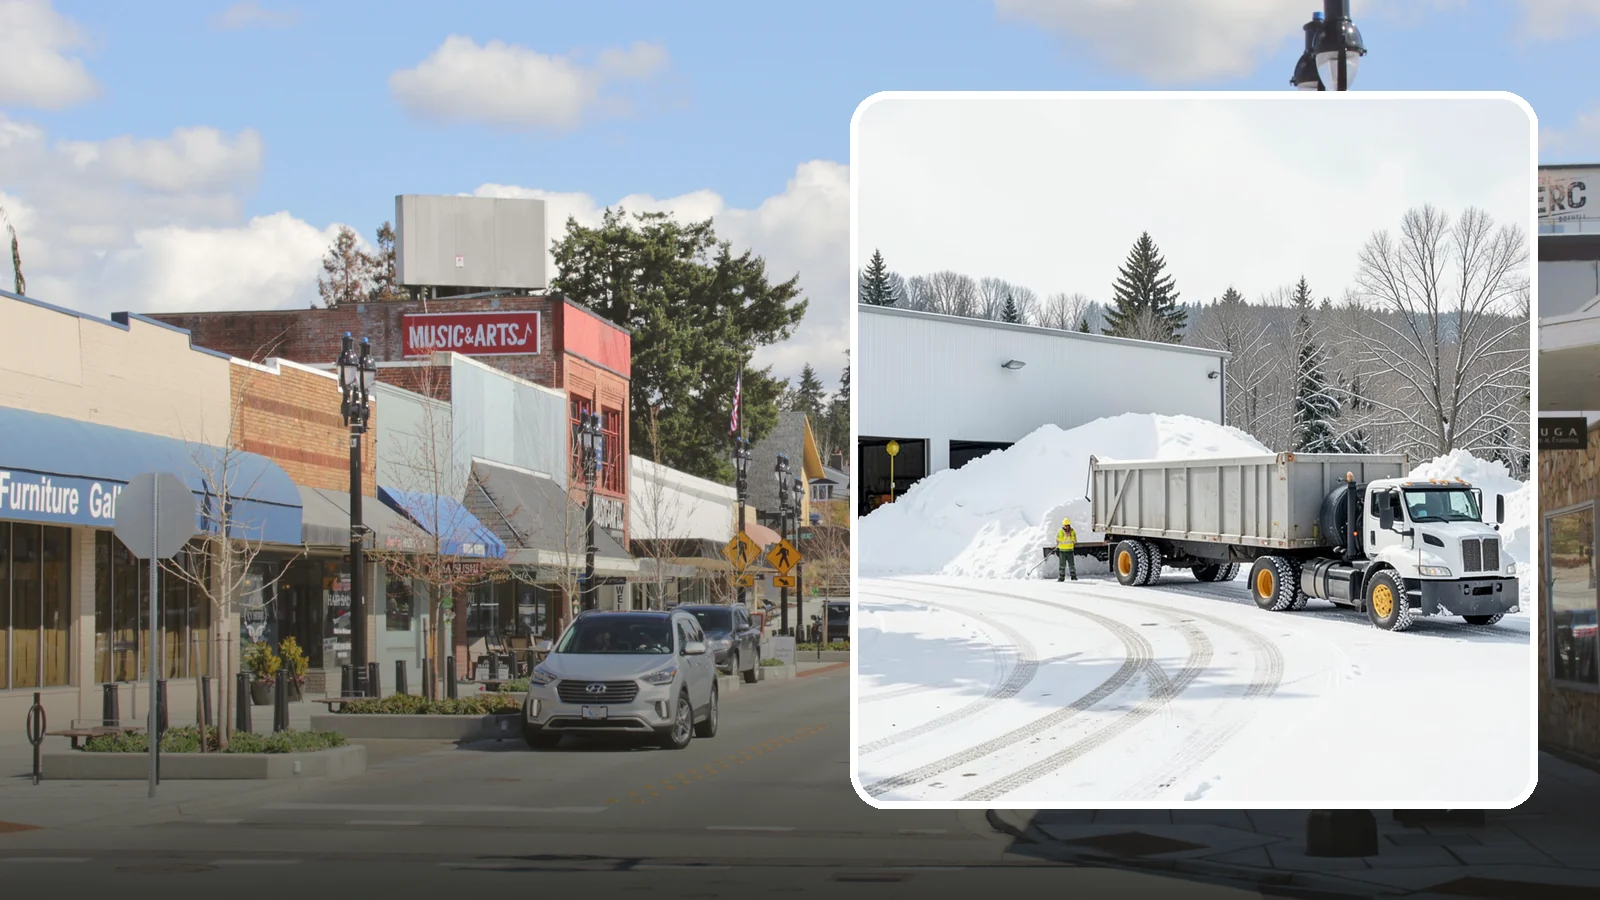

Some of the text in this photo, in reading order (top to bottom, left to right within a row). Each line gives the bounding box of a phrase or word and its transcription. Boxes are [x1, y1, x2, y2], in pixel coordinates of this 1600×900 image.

[1540, 427, 1578, 437] UGA
[0, 471, 80, 515] Furniture
[453, 563, 480, 574] SUSHI
